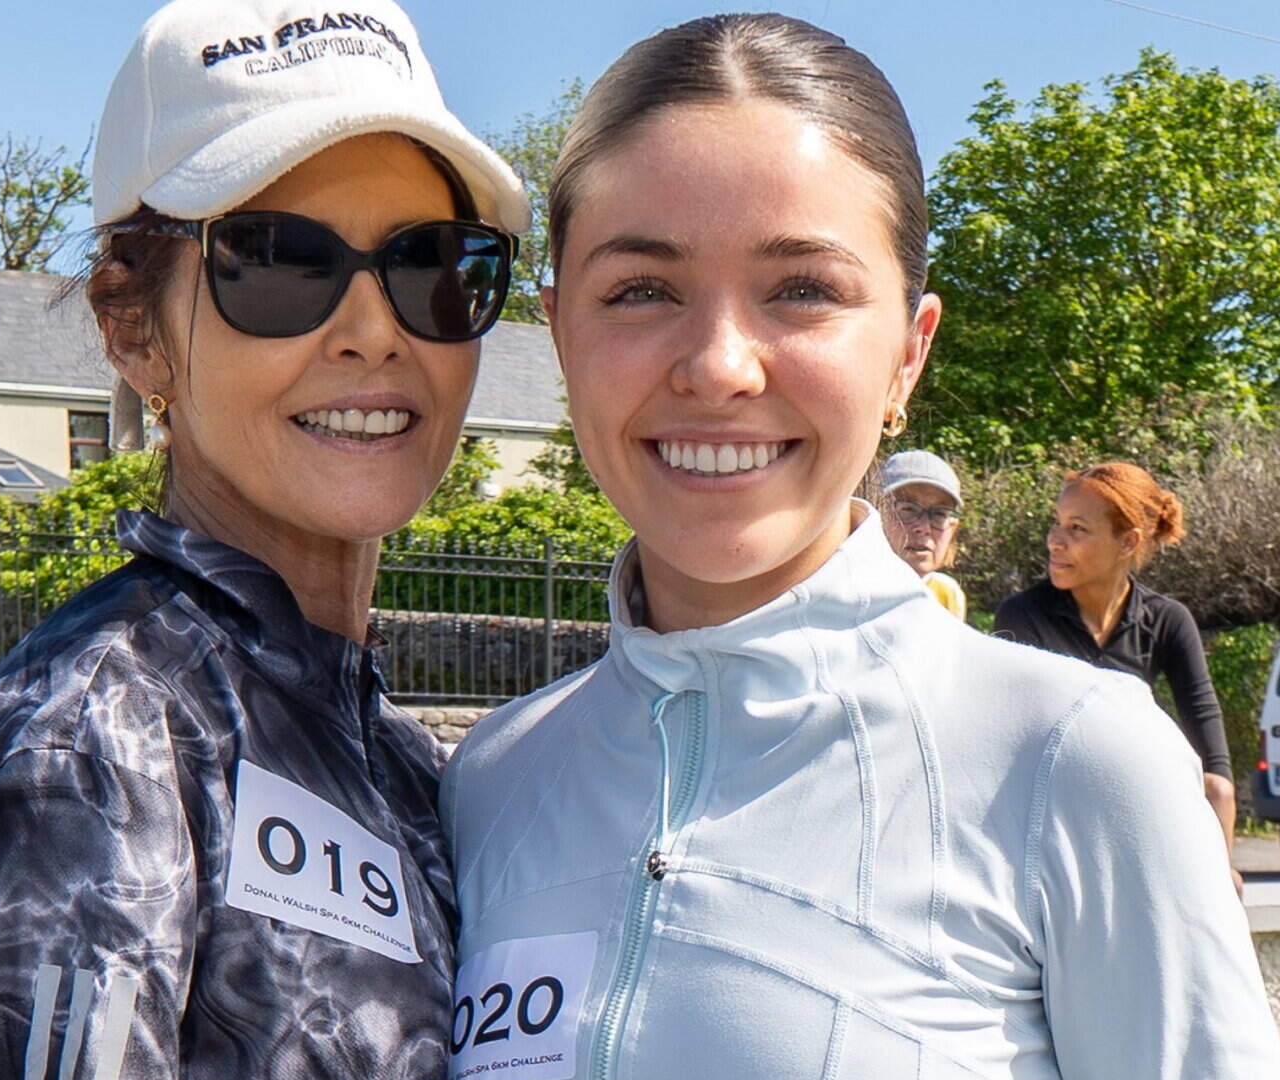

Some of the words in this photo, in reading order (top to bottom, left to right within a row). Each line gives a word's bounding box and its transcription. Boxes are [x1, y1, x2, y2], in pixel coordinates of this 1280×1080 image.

[201, 34, 267, 67] SAN
[257, 816, 399, 917] 019
[244, 883, 279, 902] DONAL
[282, 896, 318, 914] WALSH
[319, 908, 340, 922] SPA
[449, 976, 564, 1055] 020
[511, 1053, 564, 1067] CHALLENGE
